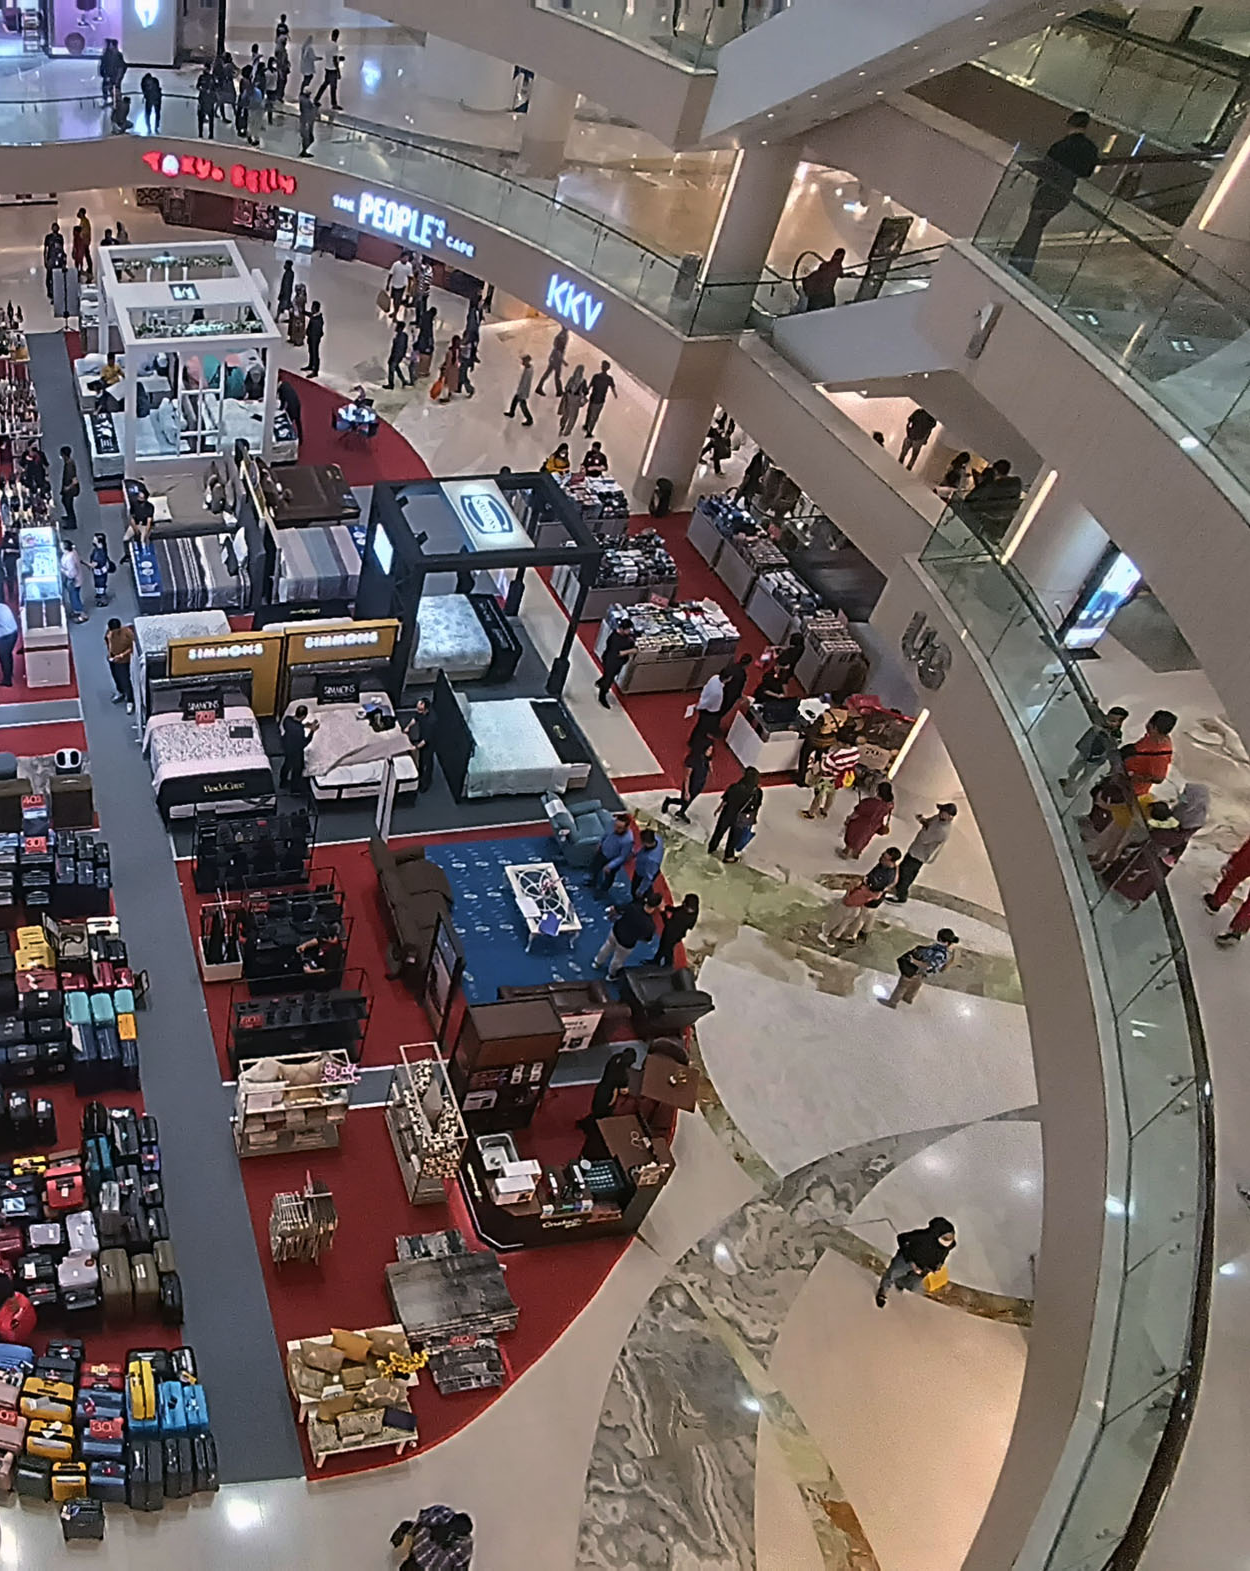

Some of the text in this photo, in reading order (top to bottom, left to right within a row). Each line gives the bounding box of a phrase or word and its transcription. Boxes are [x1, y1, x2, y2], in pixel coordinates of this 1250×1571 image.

[358, 191, 446, 249] PEOPLE'S
[546, 273, 604, 331] KKV
[188, 643, 263, 660] SIMMONS
[304, 631, 378, 649] SIMMONS
